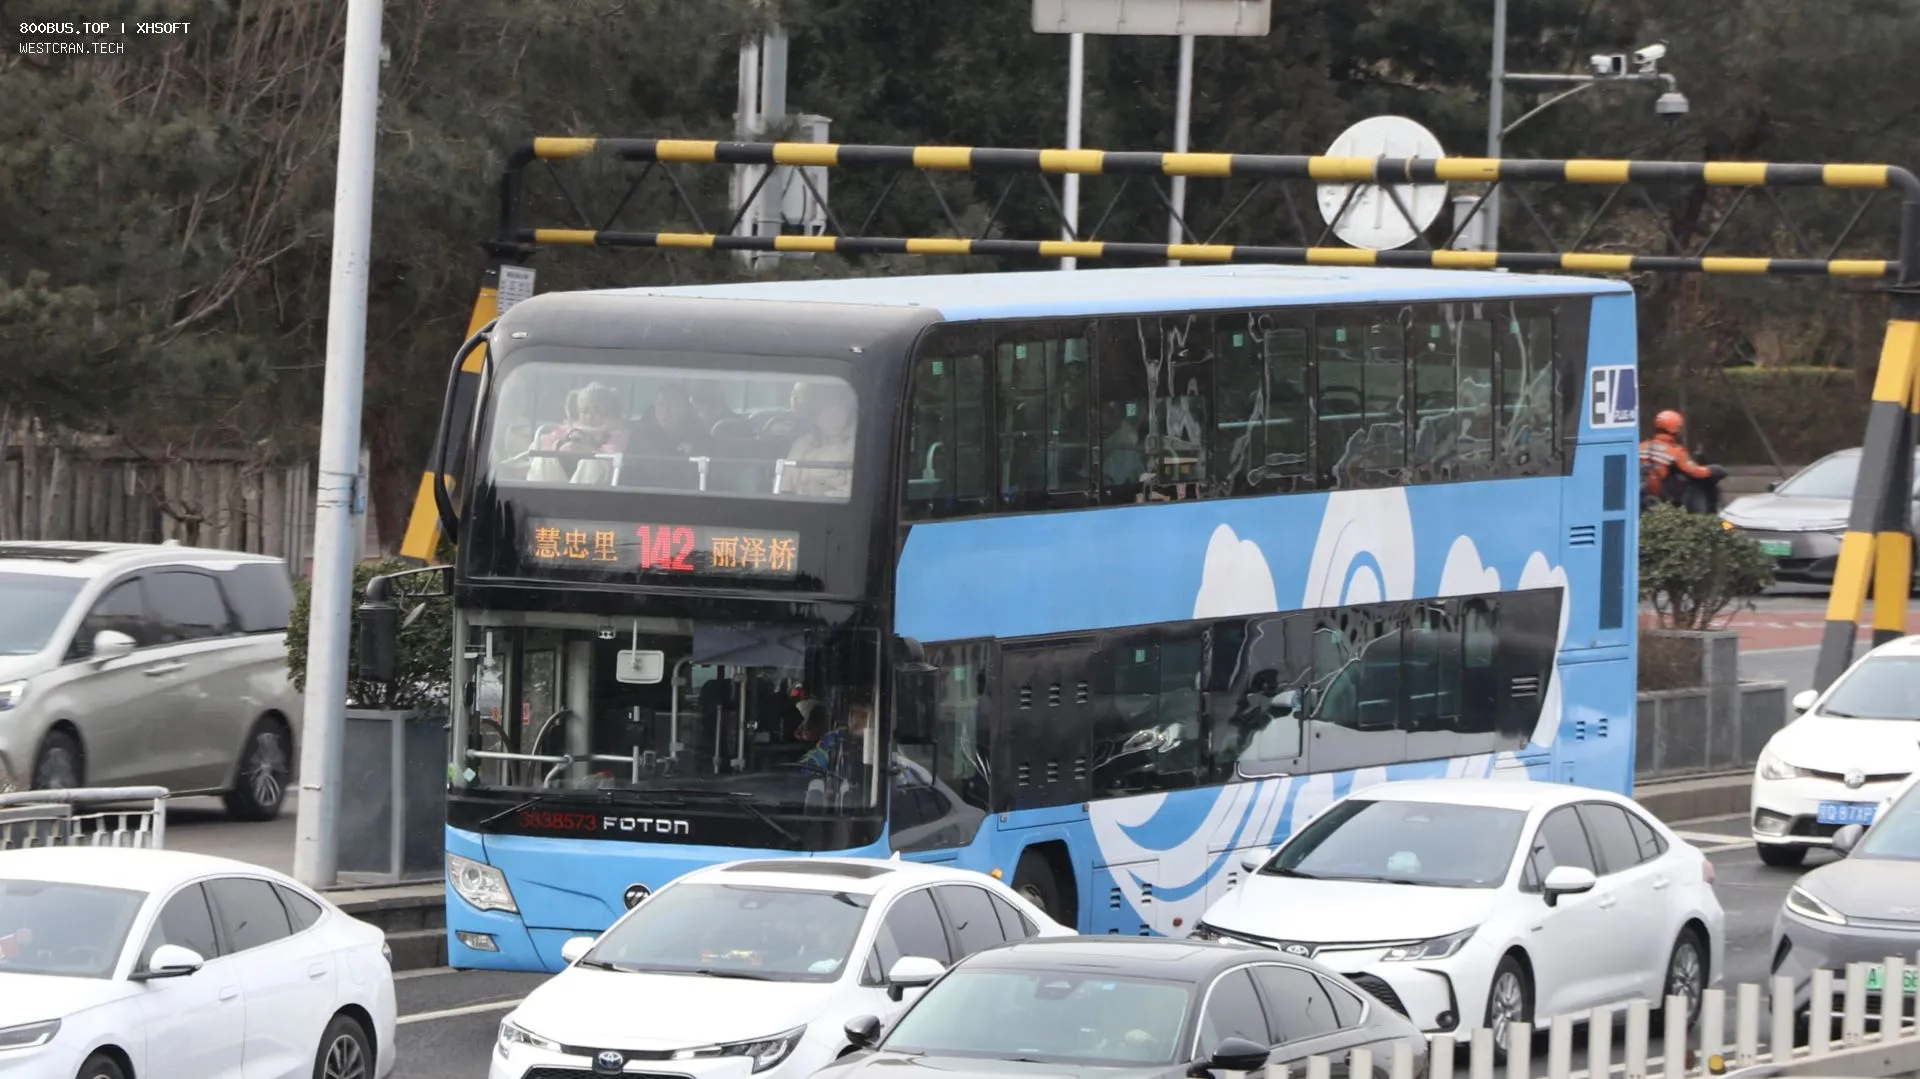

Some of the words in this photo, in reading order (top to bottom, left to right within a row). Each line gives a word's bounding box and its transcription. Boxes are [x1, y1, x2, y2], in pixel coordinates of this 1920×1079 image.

[535, 527, 618, 562] 慧忠里
[636, 524, 696, 571] 142
[711, 536, 797, 571] 丽泽桥
[603, 816, 690, 835] FOTON
